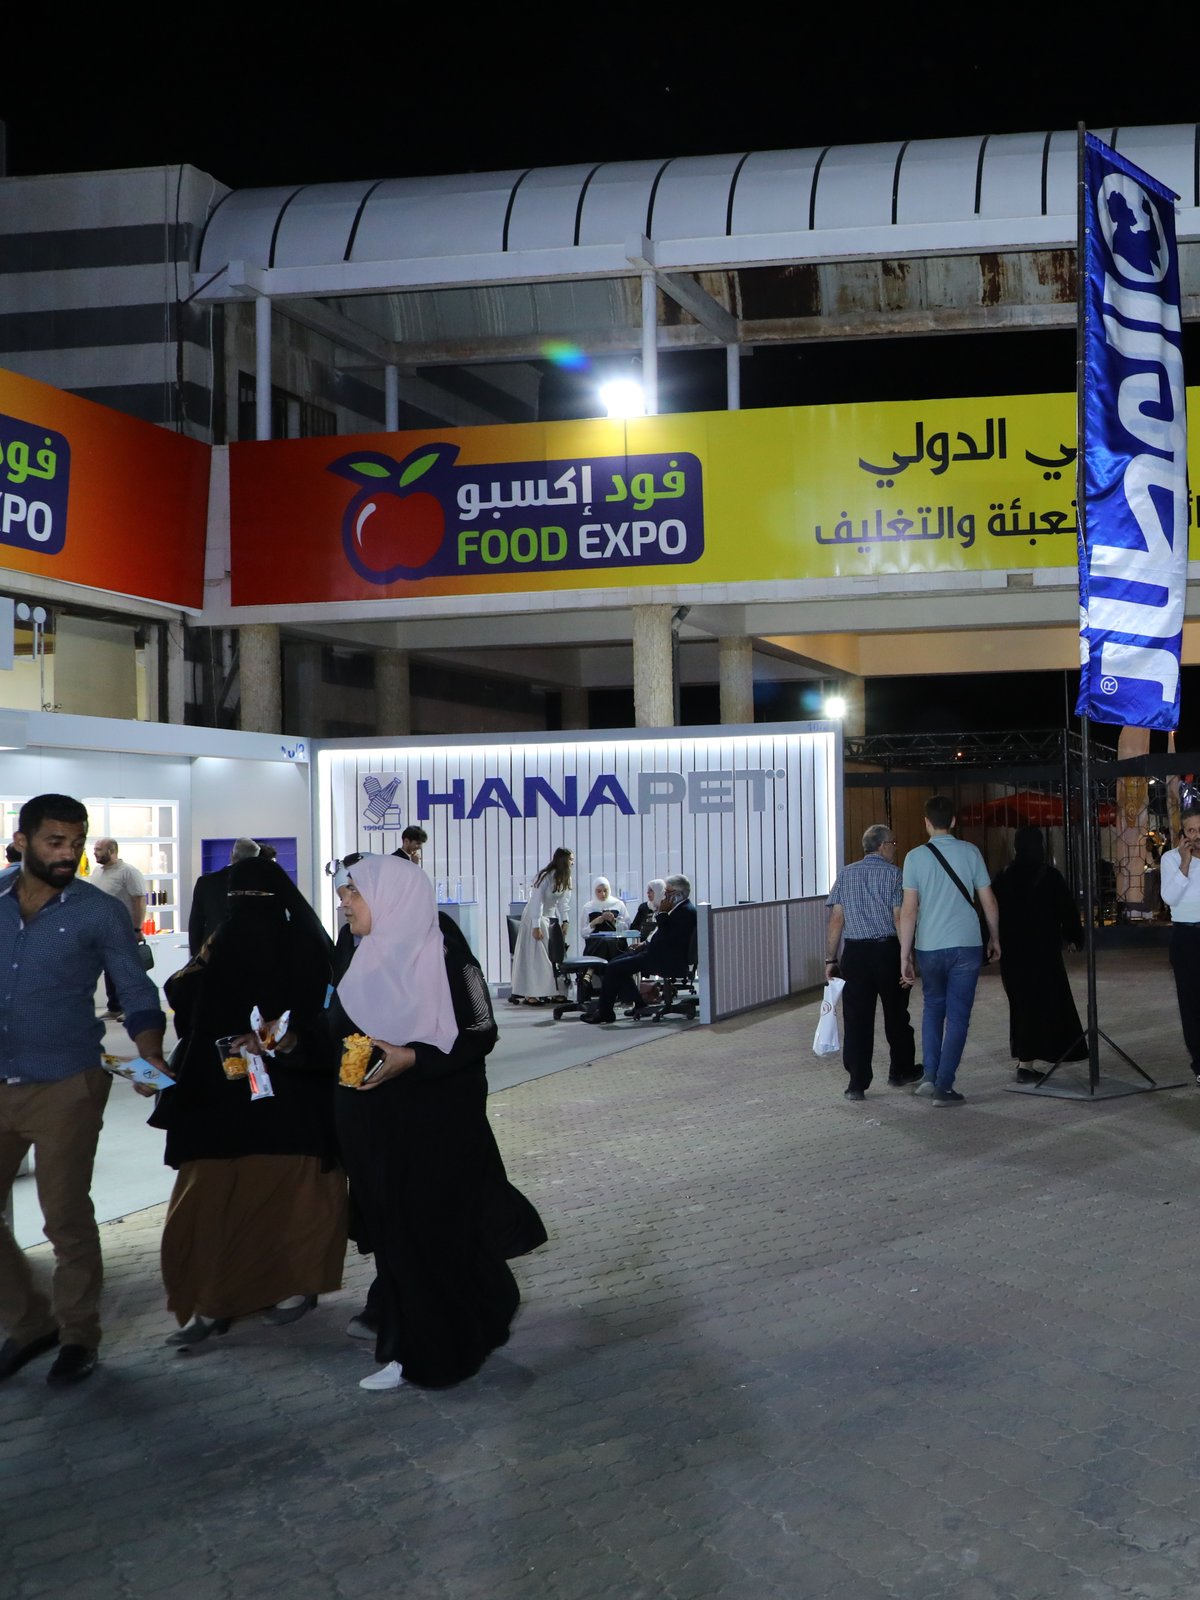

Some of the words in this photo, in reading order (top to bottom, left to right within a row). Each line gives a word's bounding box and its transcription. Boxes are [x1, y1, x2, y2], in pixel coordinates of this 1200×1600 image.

[0, 437, 58, 485] فو
[859, 417, 1006, 488] الدولي
[457, 466, 592, 521] إكسبو
[605, 460, 687, 511] فود
[0, 500, 53, 544] PO
[457, 525, 568, 567] FOOD
[579, 519, 688, 560] EXPO
[815, 506, 975, 554] والتغليف
[416, 769, 770, 821] HANAPET
